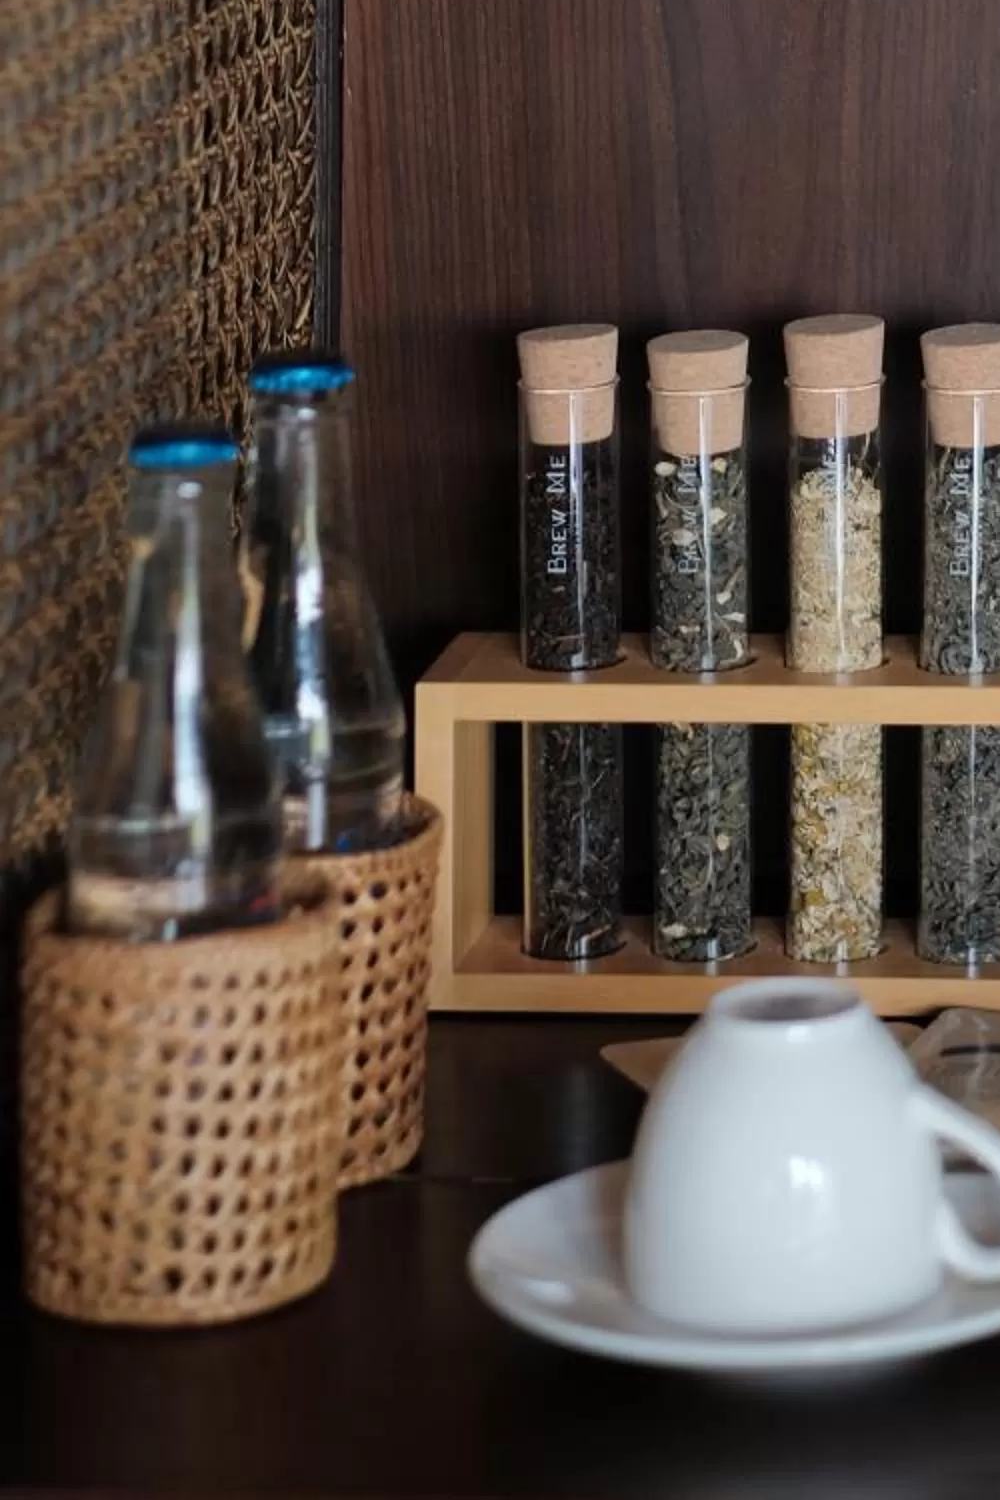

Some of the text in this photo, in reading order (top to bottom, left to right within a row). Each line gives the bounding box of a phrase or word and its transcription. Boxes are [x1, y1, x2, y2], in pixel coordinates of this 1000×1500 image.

[547, 455, 568, 575] BREW ME
[678, 509, 698, 574] BRW
[950, 455, 971, 577] BREW ME
